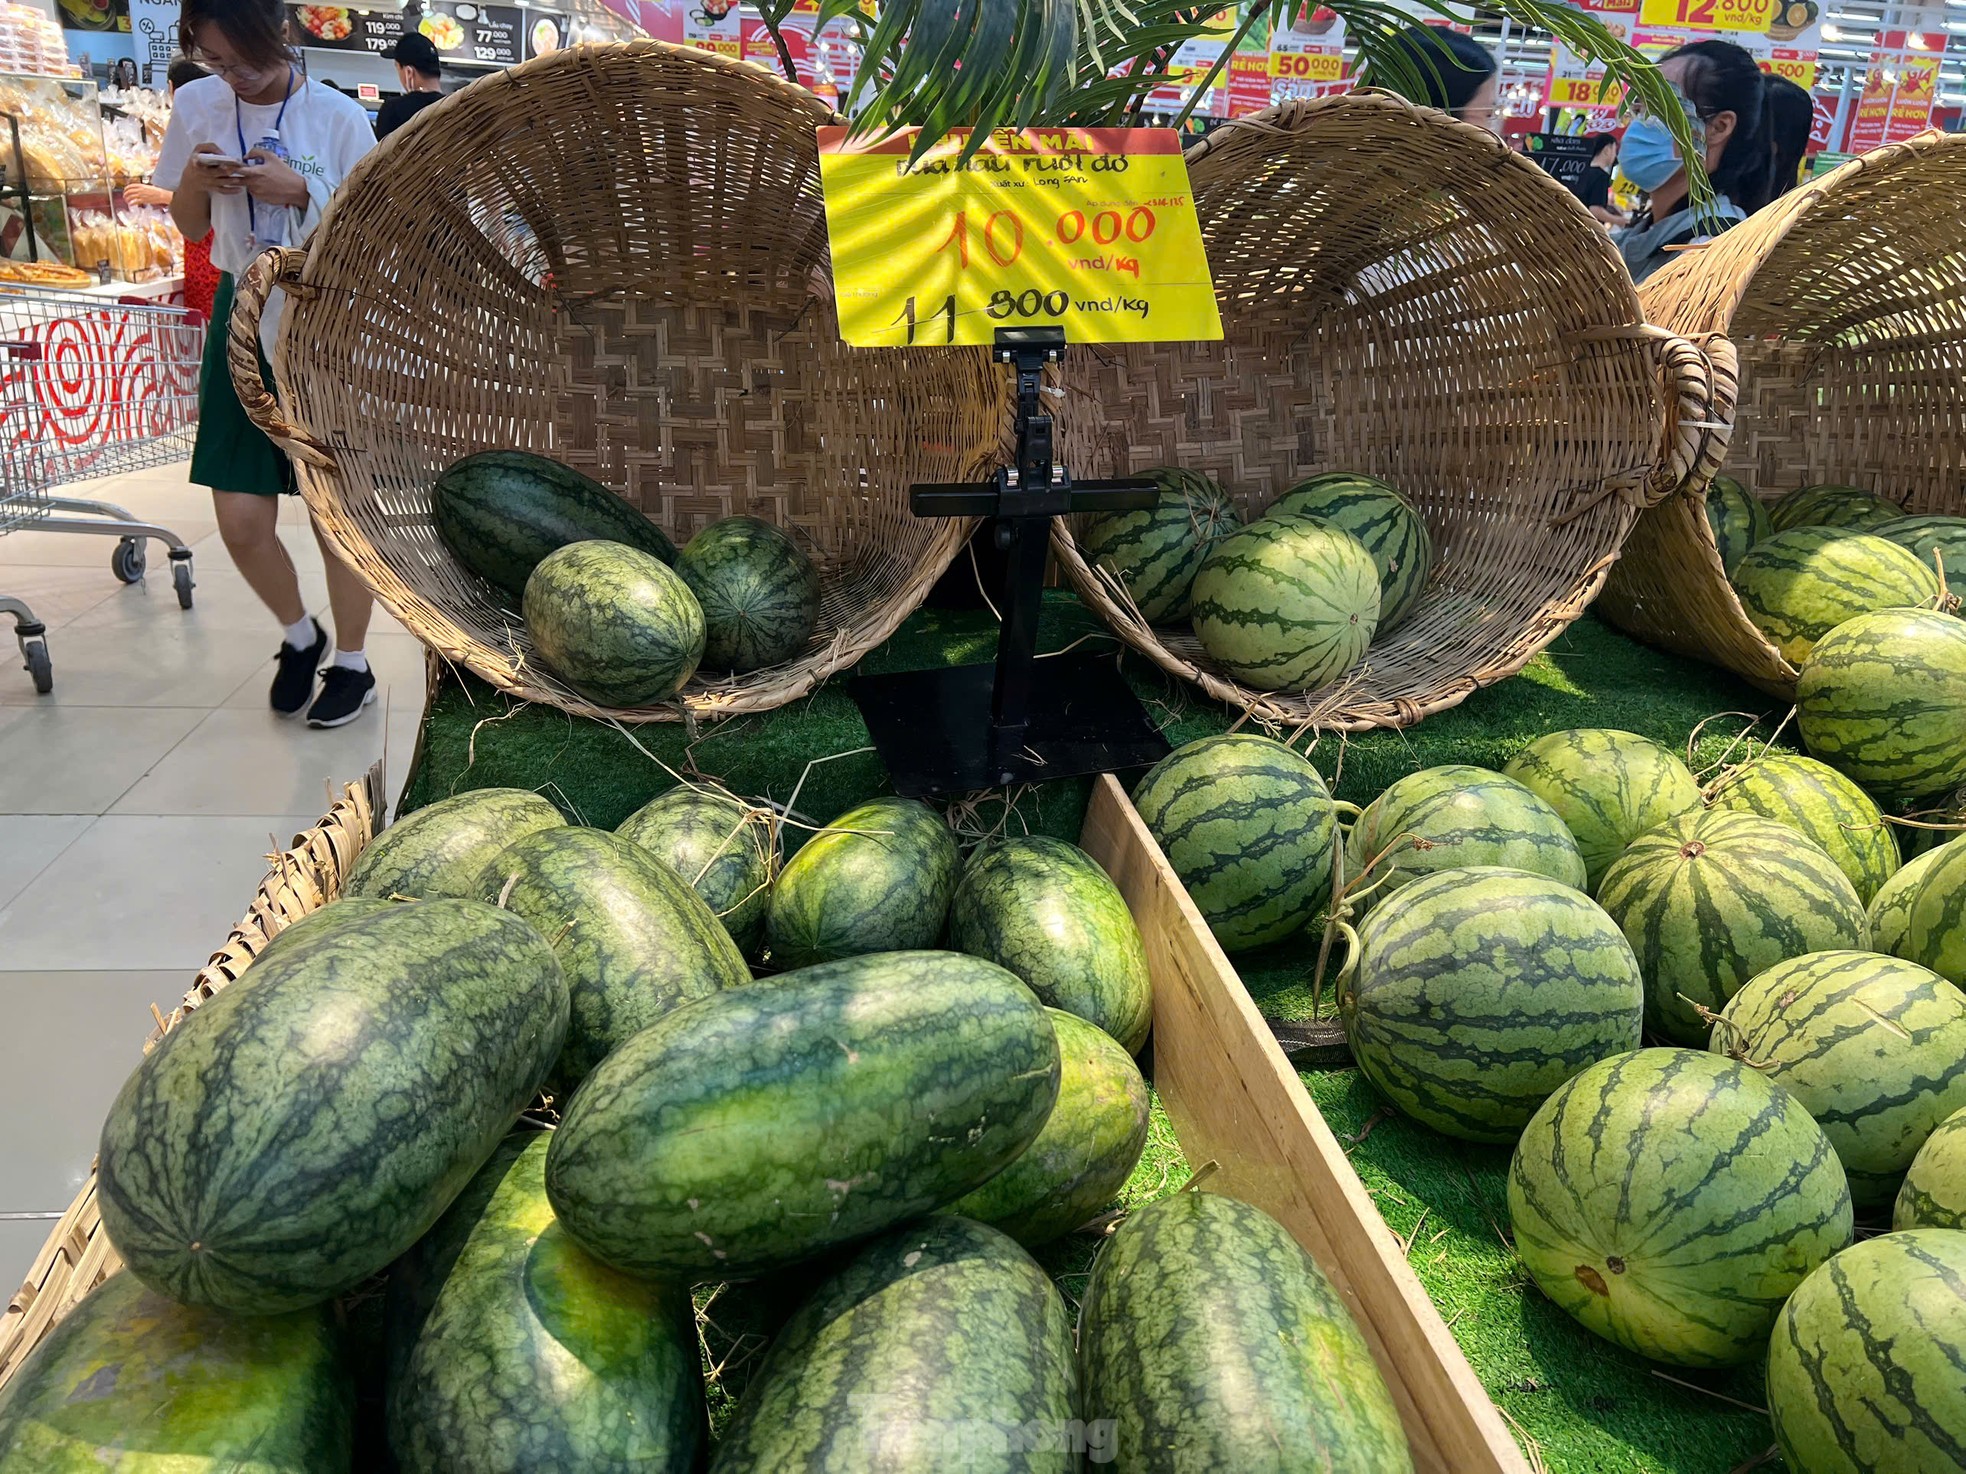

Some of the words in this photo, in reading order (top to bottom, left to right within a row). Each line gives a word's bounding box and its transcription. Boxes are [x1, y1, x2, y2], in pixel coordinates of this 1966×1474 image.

[476, 29, 492, 43] 77
[1278, 55, 1310, 76] 50
[1568, 82, 1591, 101] 18
